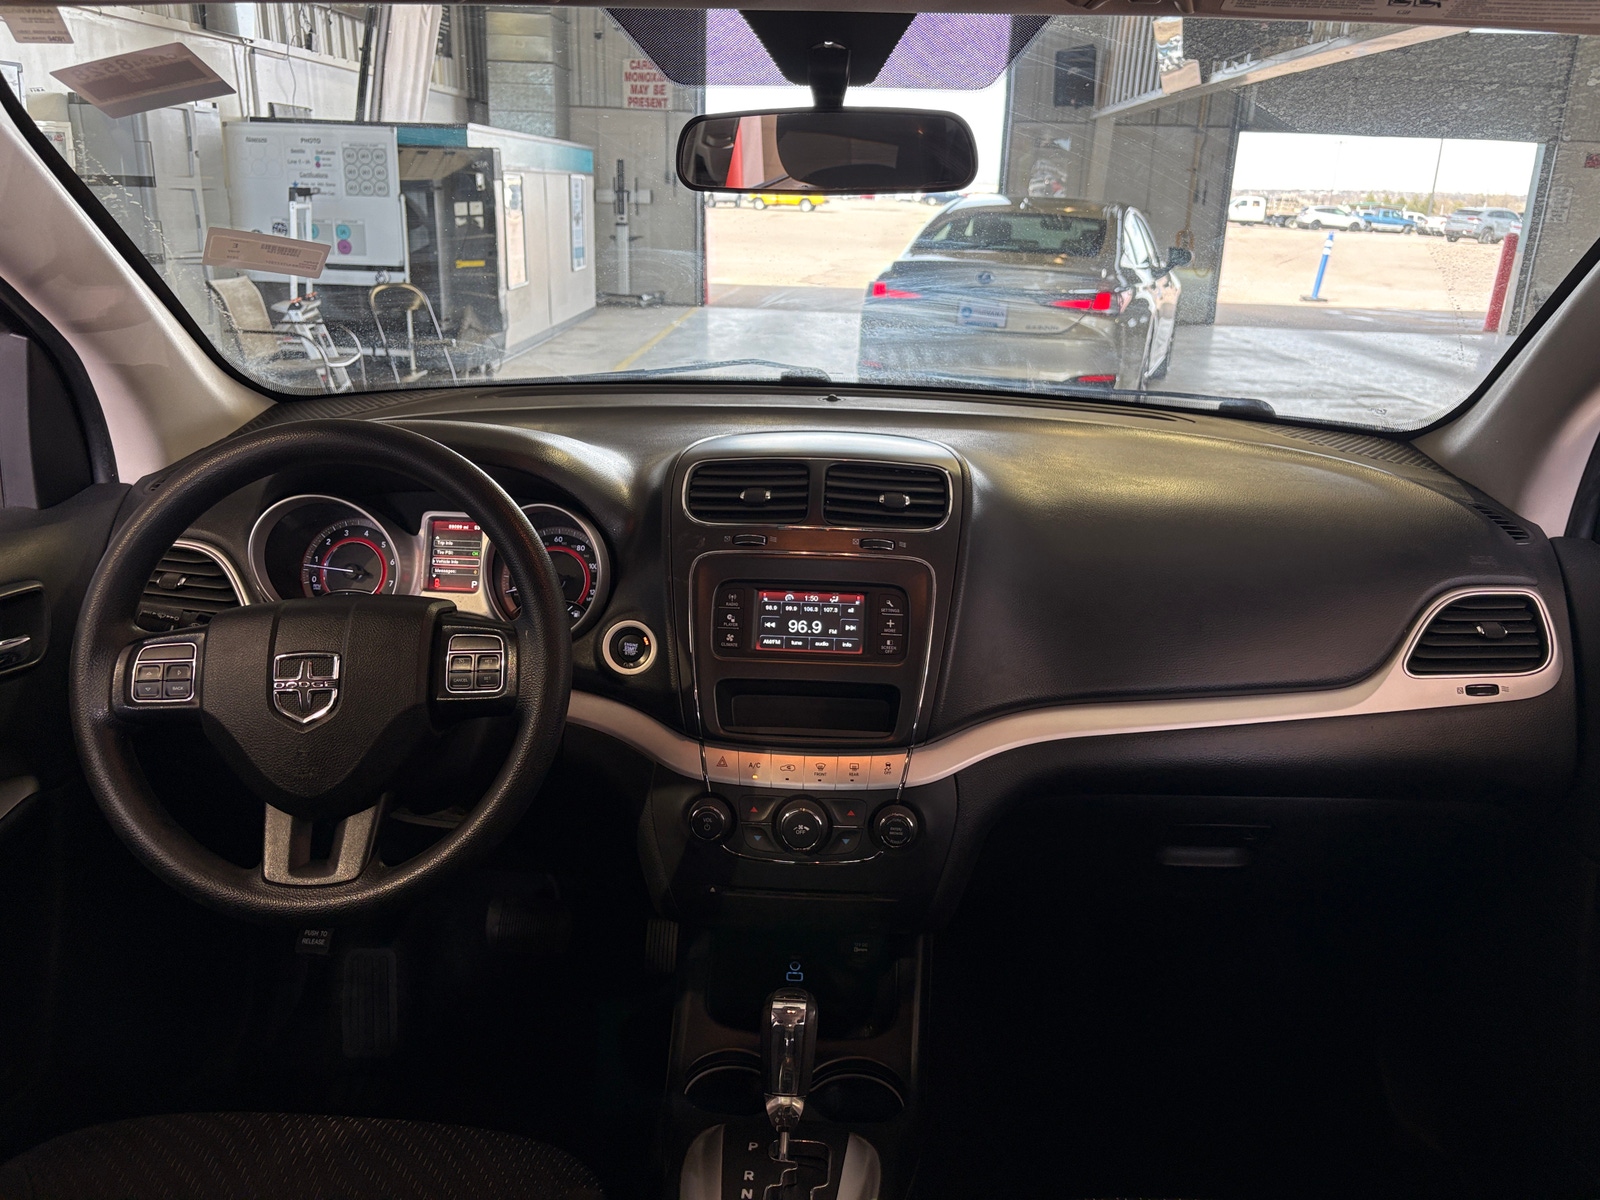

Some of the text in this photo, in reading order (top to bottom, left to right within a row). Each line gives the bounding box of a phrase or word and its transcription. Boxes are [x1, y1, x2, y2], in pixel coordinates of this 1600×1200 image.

[630, 84, 666, 95] MAY BE
[627, 96, 668, 108] PRESENT
[471, 580, 478, 588] P
[788, 620, 822, 634] 96.9
[274, 681, 336, 689] DODGE
[748, 1142, 758, 1151] P
[744, 1171, 754, 1180] R
[741, 1189, 753, 1199] N
